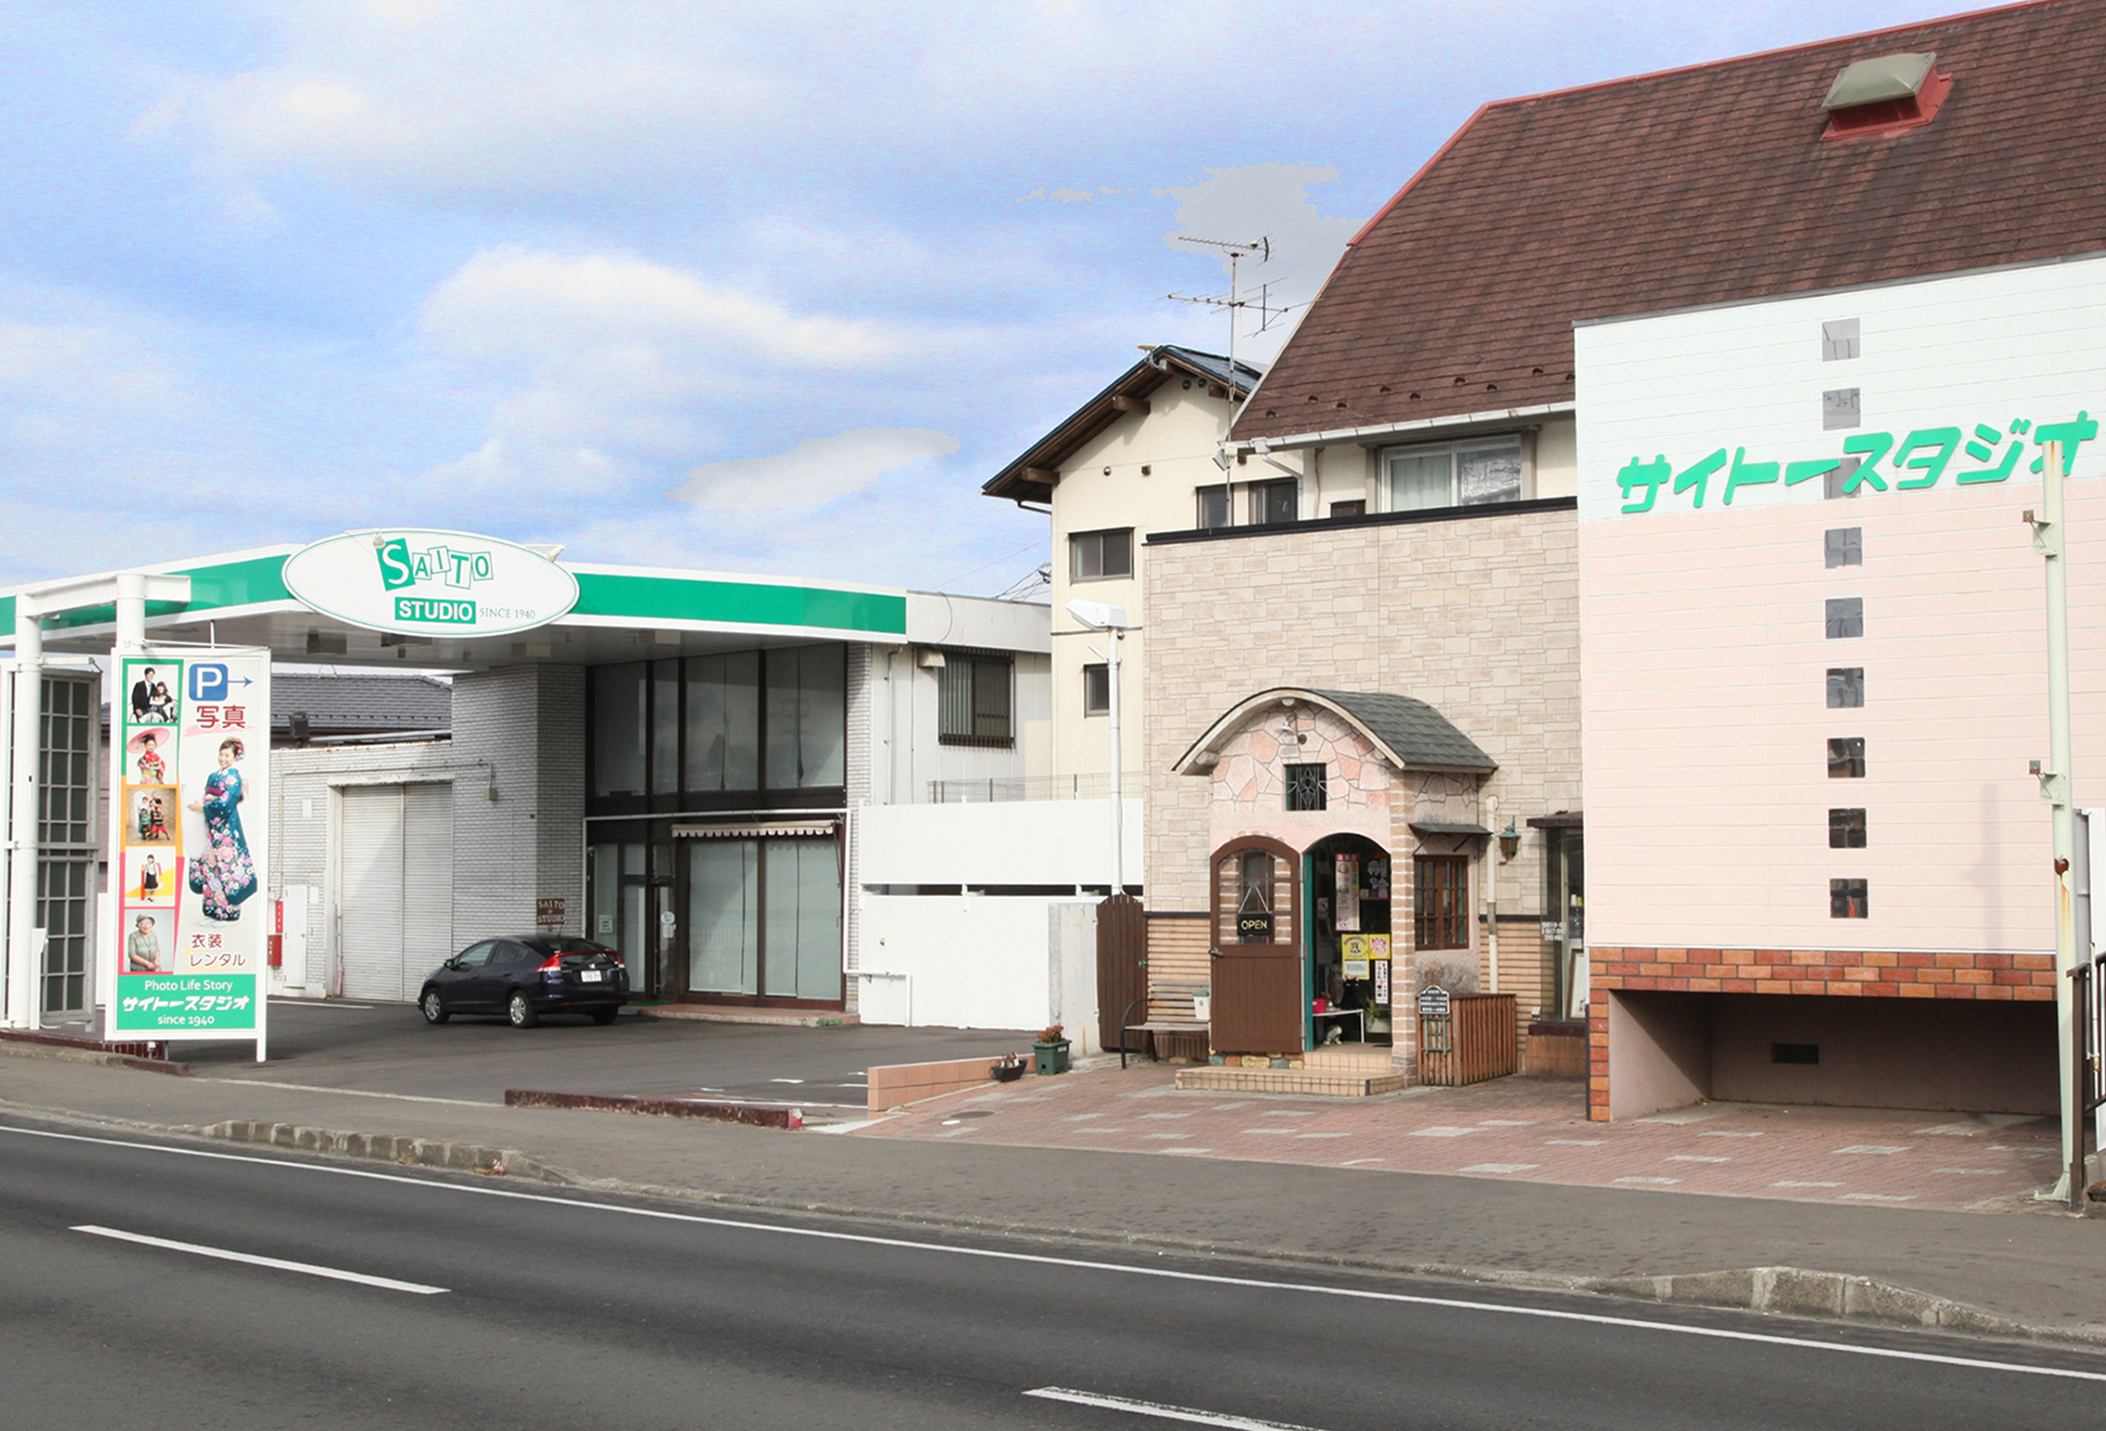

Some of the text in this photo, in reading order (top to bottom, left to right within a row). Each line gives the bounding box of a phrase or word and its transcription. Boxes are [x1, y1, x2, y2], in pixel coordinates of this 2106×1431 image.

[1616, 410, 2099, 514] サイトースタジオ
[379, 541, 491, 587] SAITO
[398, 600, 474, 621] STUDIO
[480, 607, 536, 620] SINCE 1940
[196, 667, 223, 698] P
[196, 705, 246, 729] 写真
[537, 899, 565, 910] SAITO
[1241, 920, 1268, 931] OPEN
[191, 933, 223, 949] 衣装
[190, 953, 247, 967] レンタル
[145, 980, 233, 992] Photo Life Story
[122, 995, 250, 1012] サイトースタジオ
[157, 1014, 215, 1027] since 1940
